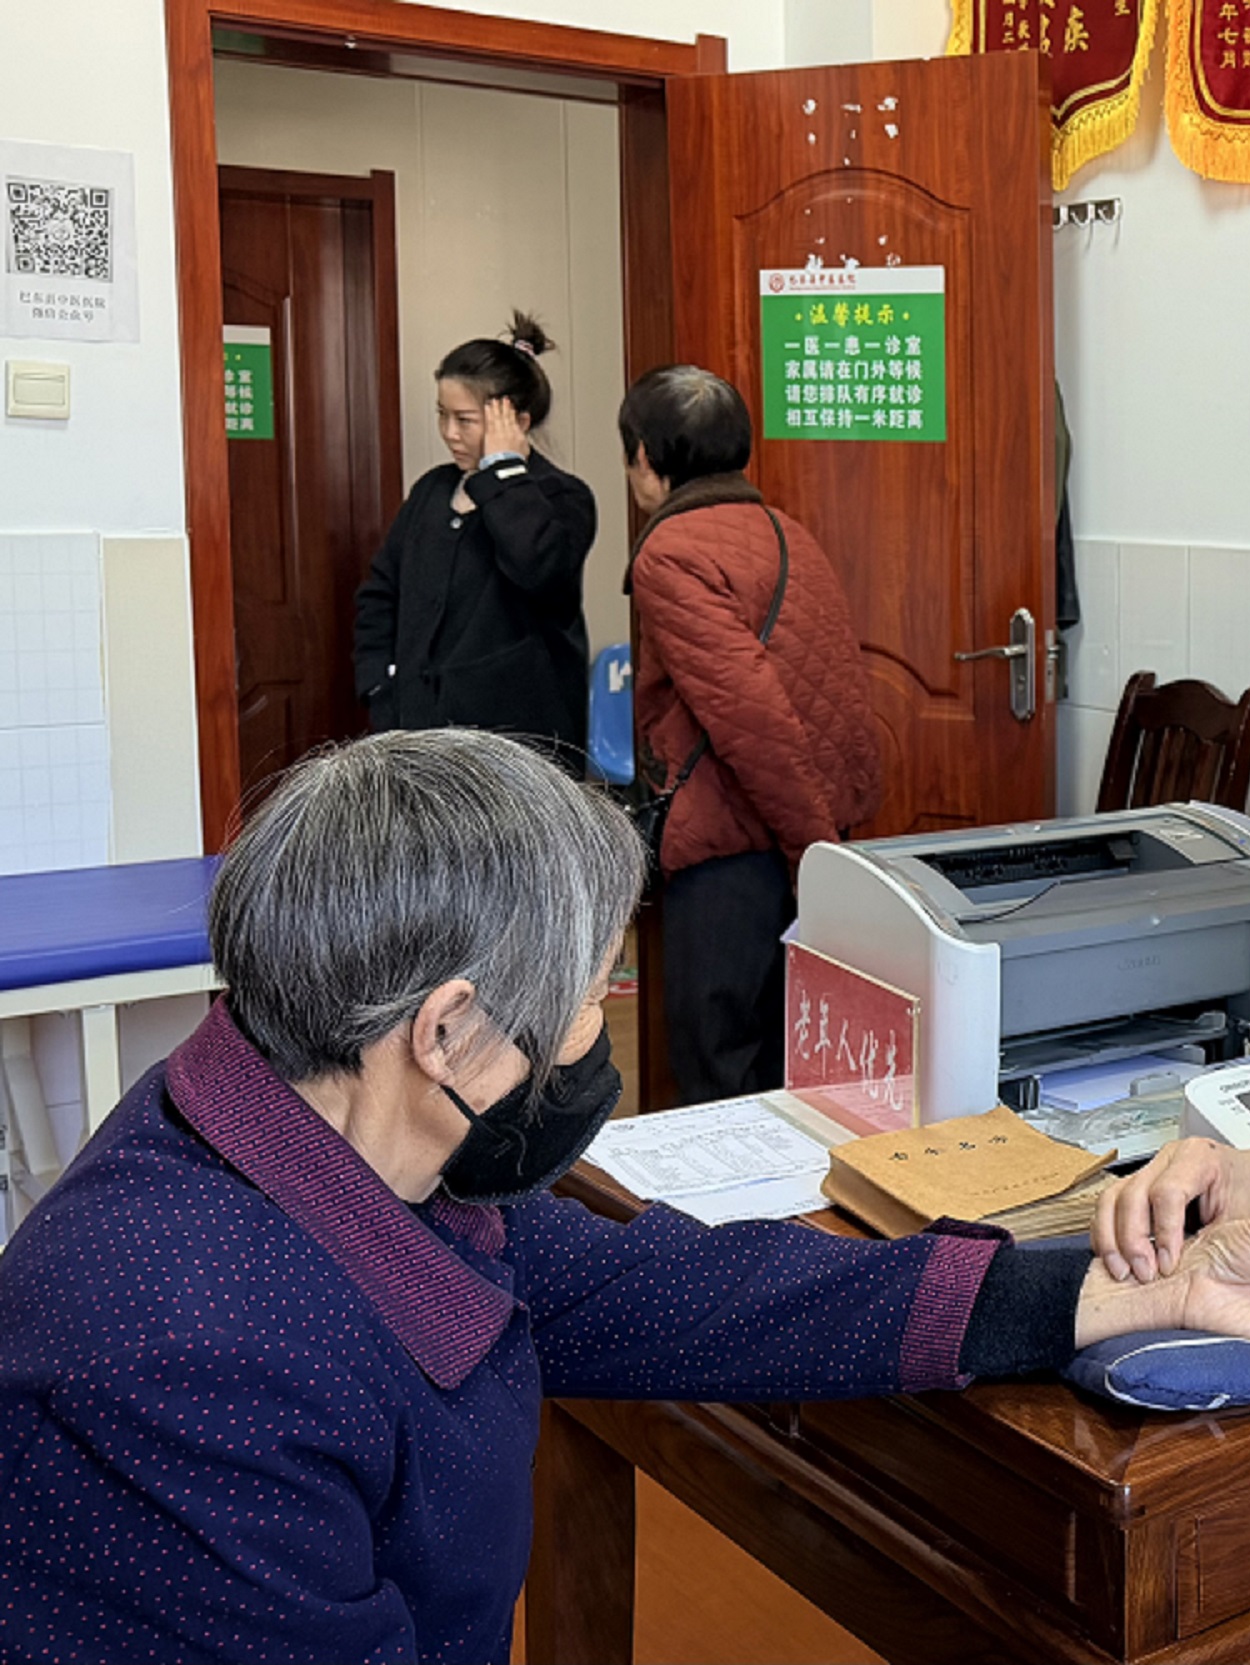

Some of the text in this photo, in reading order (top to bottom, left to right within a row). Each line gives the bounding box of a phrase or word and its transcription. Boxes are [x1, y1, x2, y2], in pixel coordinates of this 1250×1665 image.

[809, 300, 894, 328] 温馨提示
[784, 335, 922, 356] 一医一患一诊室
[784, 360, 923, 381] 家属请在门外等候
[784, 384, 923, 404] 请您排队有序就诊
[786, 408, 924, 429] 相互保持一米距离
